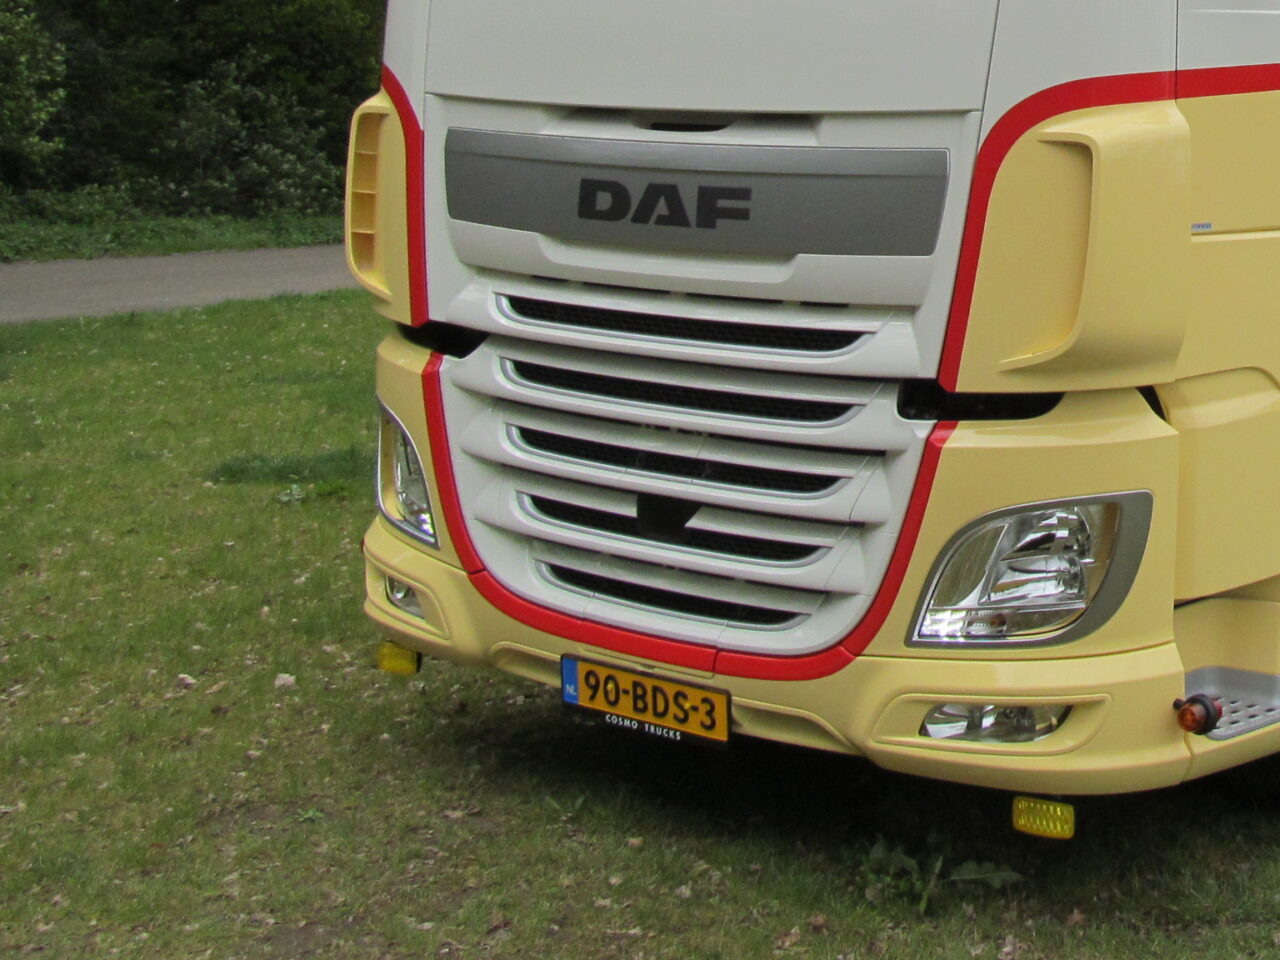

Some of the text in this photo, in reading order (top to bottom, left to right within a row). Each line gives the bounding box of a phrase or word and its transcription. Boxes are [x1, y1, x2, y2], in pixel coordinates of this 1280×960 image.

[577, 178, 752, 229] DAF
[566, 684, 577, 696] NL
[584, 669, 717, 731] 90-BDS-3
[605, 713, 681, 740] COSMO TRUCKS
